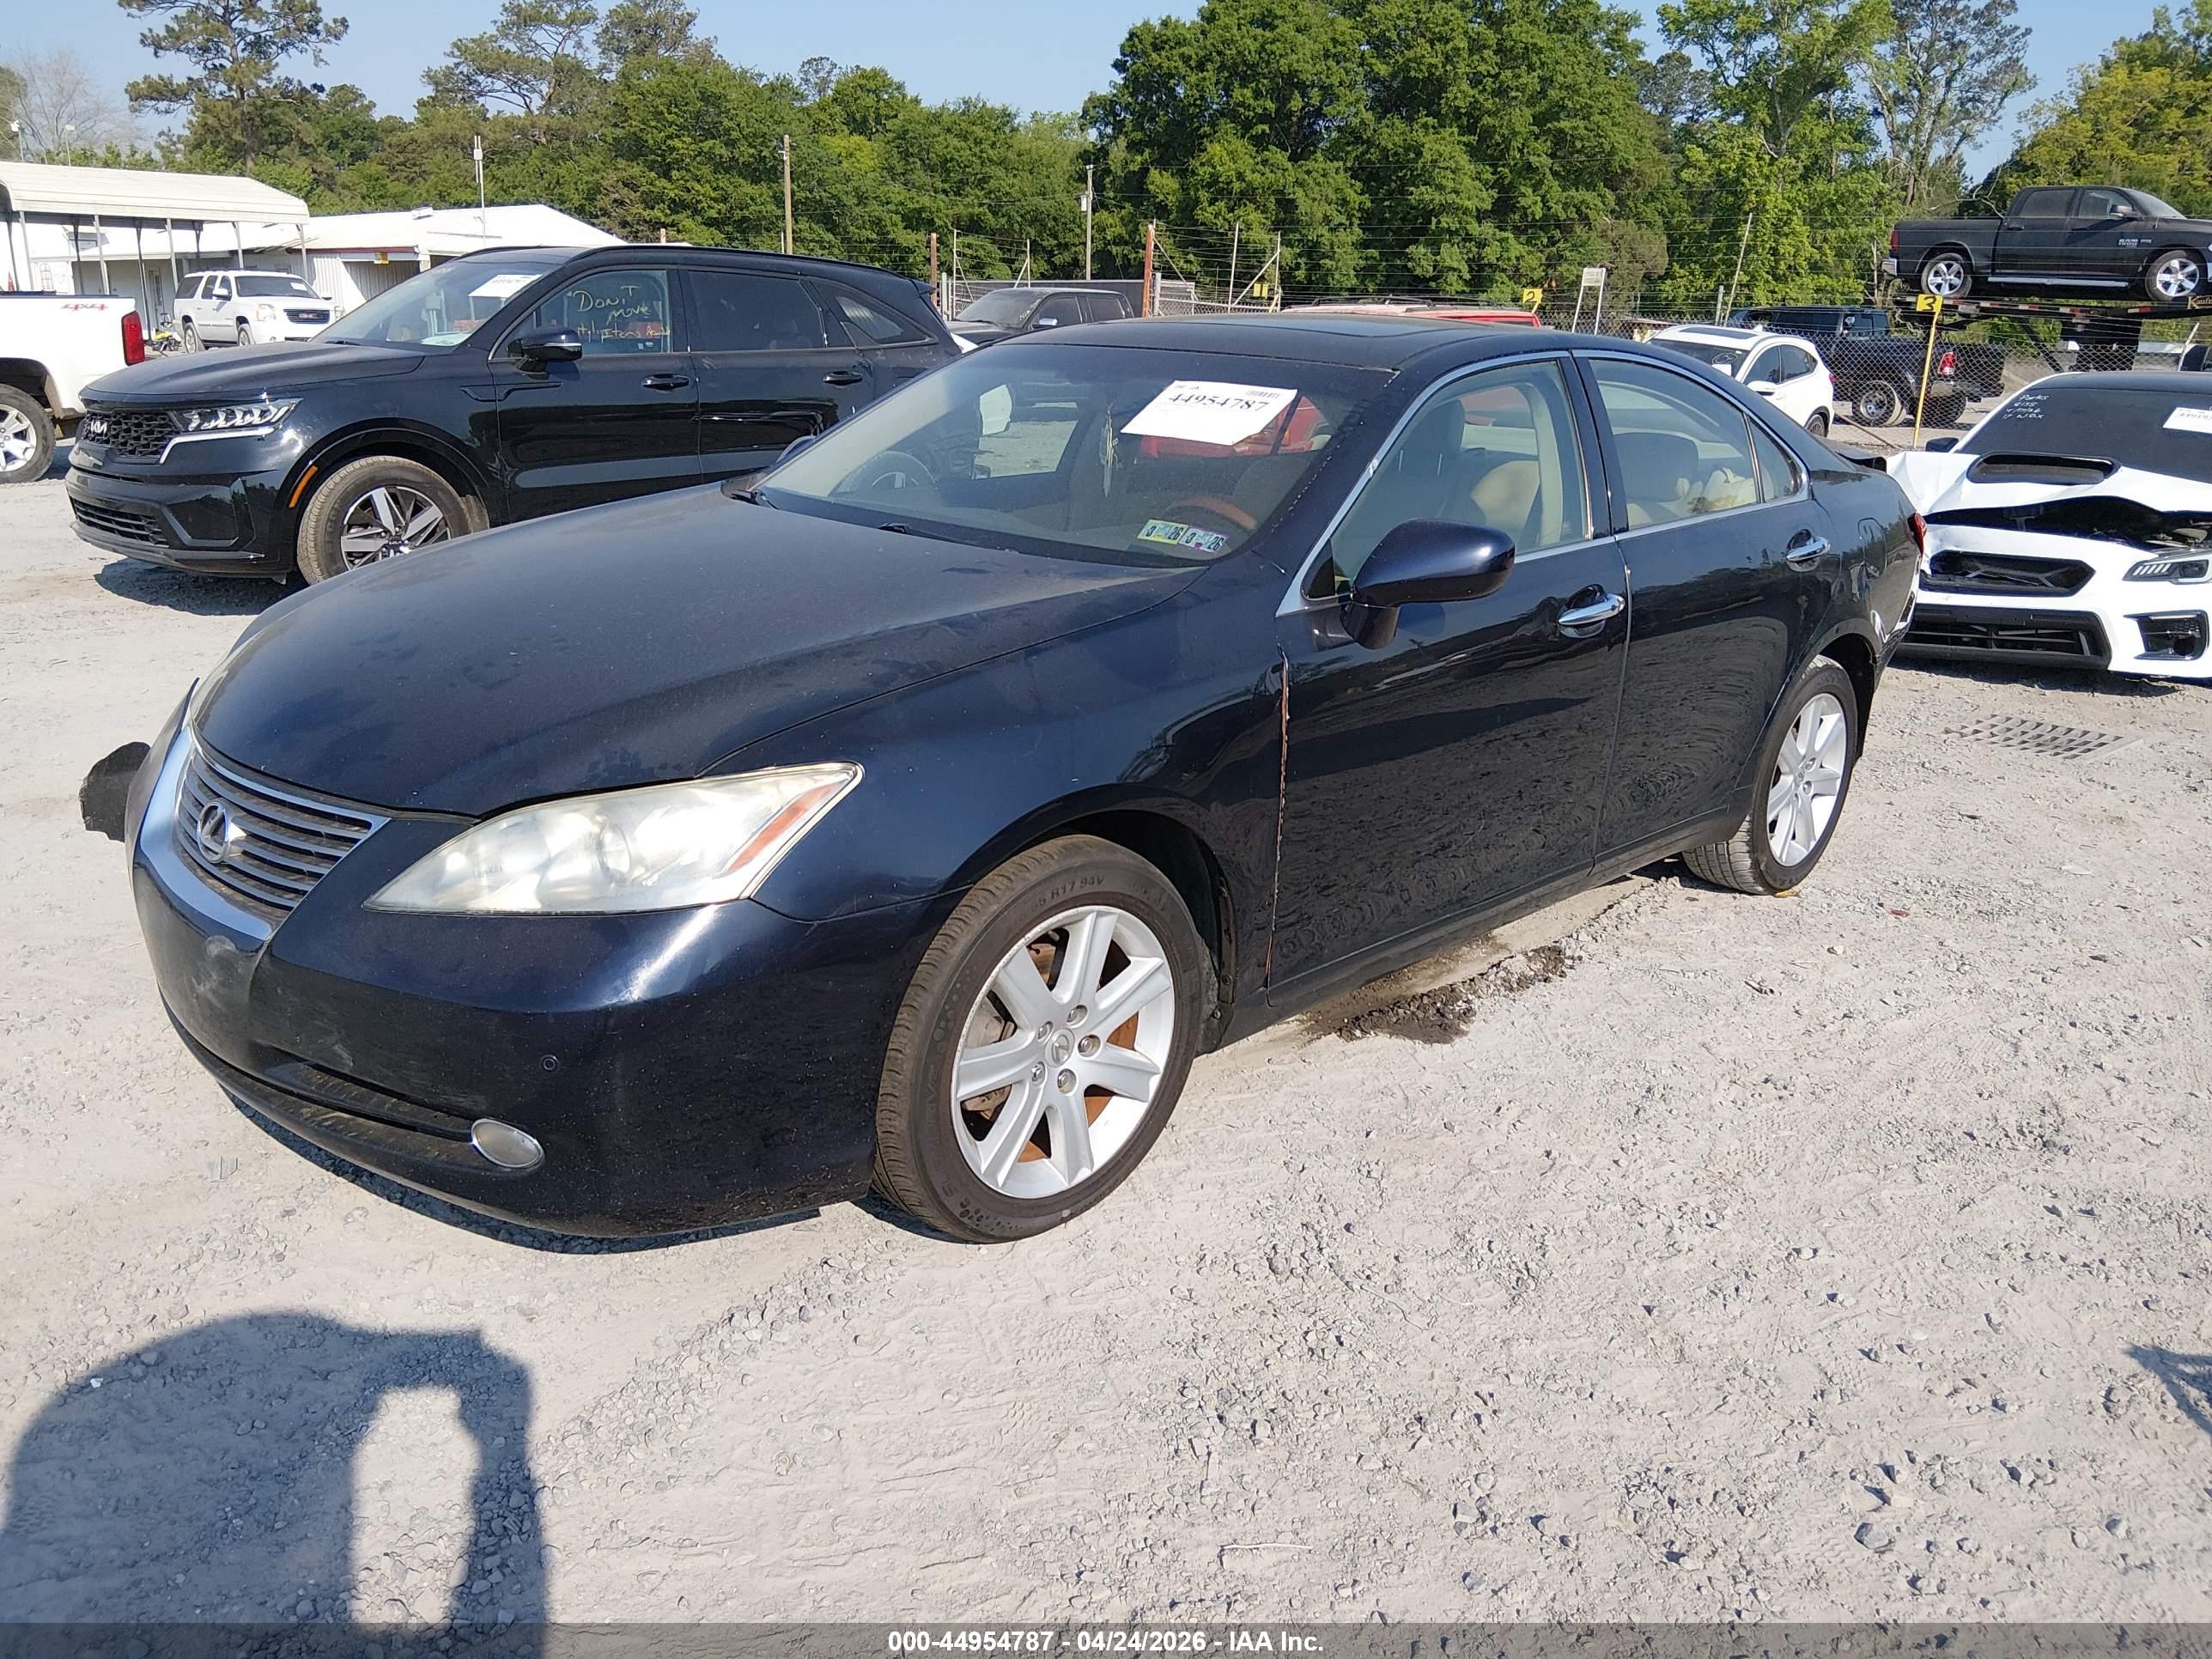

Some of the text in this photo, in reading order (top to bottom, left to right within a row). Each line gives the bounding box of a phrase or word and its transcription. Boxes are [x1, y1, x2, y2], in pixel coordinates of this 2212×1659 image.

[1524, 290, 1537, 302] 2
[1923, 295, 1937, 310] 3
[1169, 393, 1270, 412] 44954787
[1167, 526, 1184, 541] 26
[1185, 532, 1224, 551] 3 26
